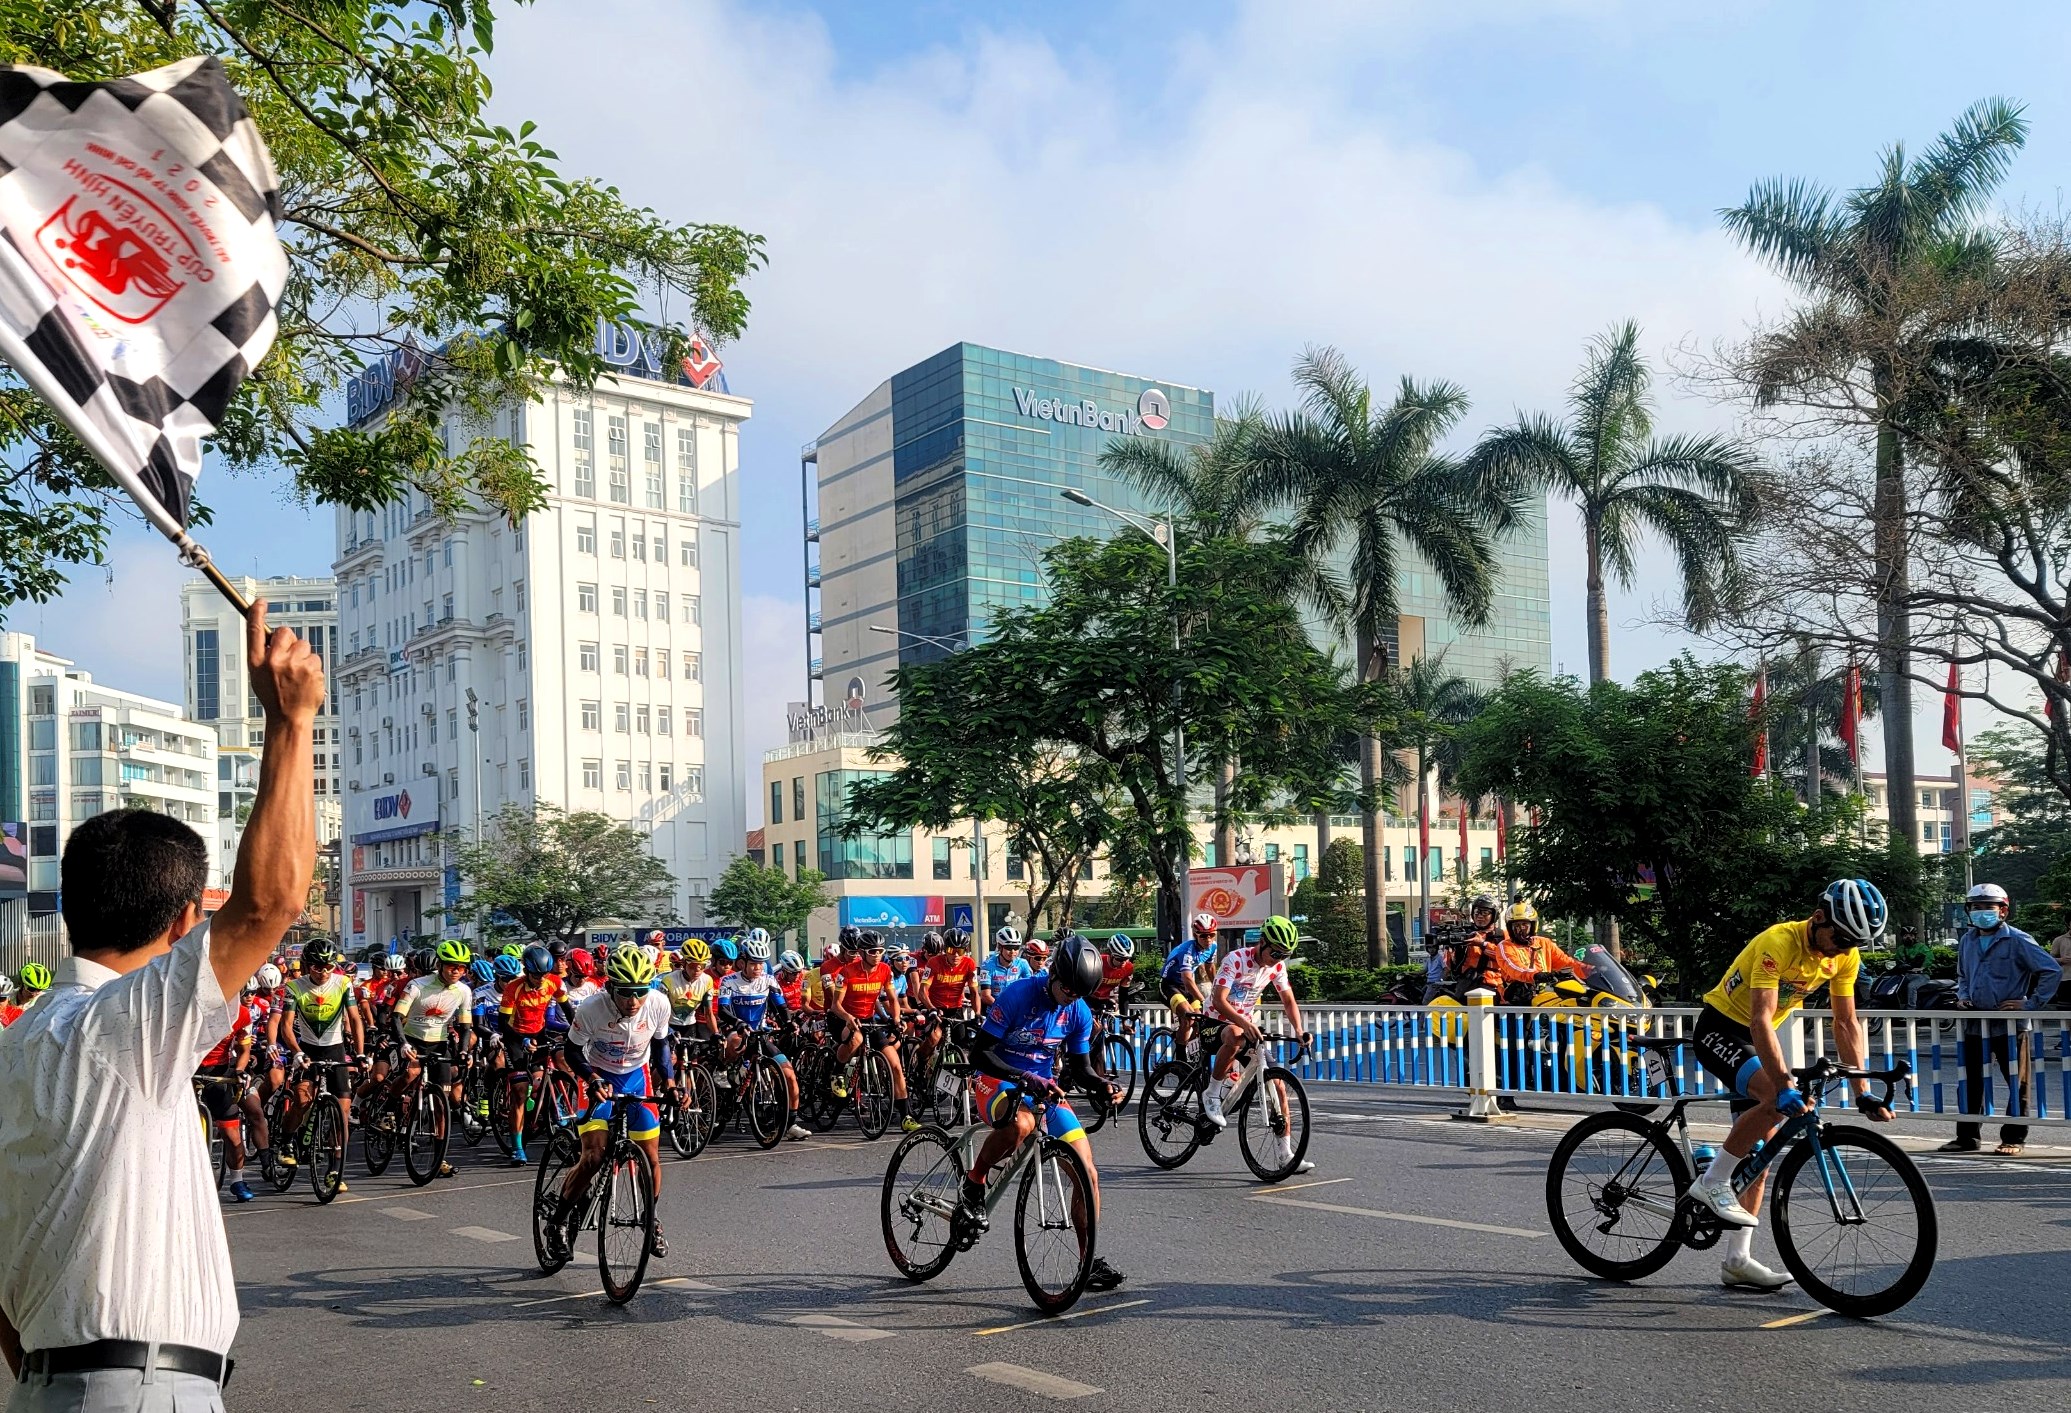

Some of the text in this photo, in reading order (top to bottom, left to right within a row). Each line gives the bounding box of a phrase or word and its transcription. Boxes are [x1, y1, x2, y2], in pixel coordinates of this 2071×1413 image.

[1012, 386, 1144, 436] VietinBank
[374, 794, 400, 821] BIDV
[924, 914, 941, 923] ATM
[591, 933, 619, 944] BIDV
[643, 931, 707, 944] AOBANK
[1648, 1058, 1661, 1076] 41
[943, 1074, 955, 1092] 91
